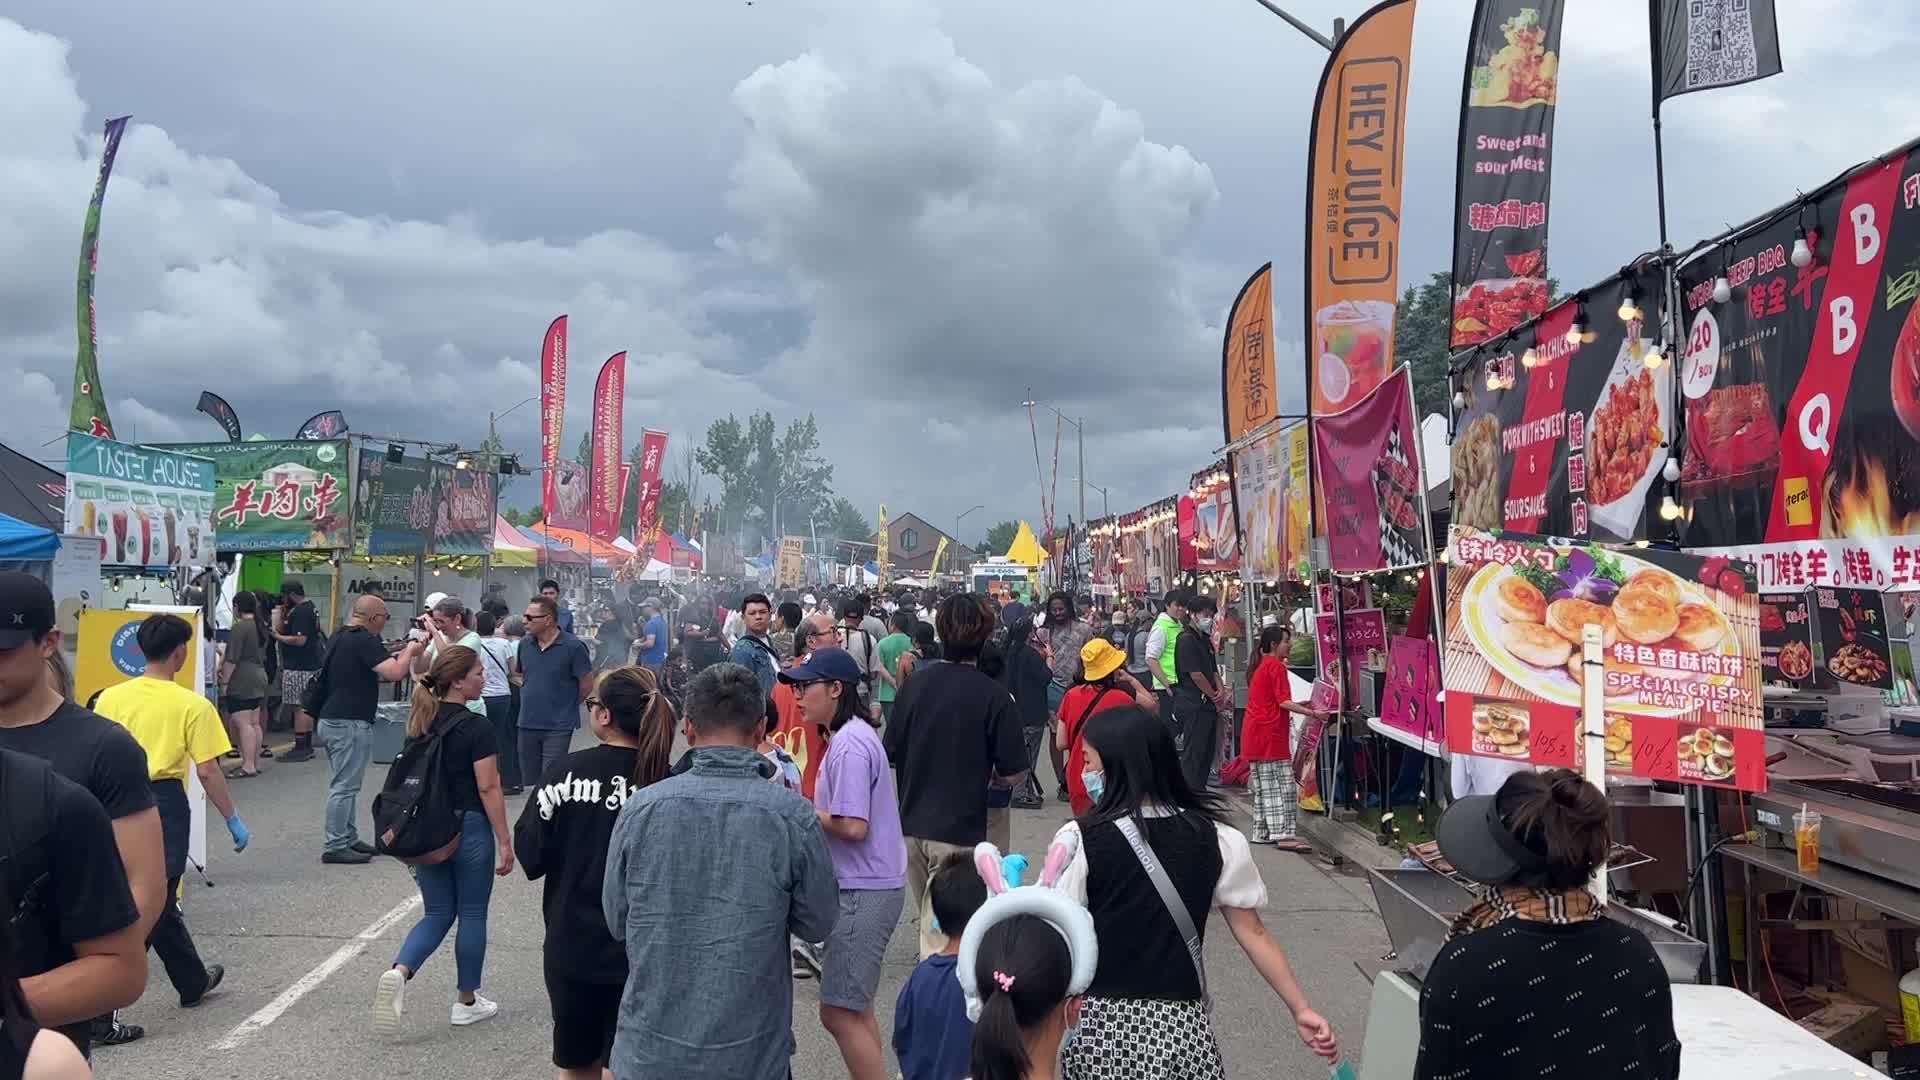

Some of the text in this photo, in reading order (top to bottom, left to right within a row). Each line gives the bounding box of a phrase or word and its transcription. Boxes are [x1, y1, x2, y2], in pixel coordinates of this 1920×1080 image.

[1476, 133, 1546, 151] Sweet and
[1343, 83, 1398, 261] HEY JUICE
[1475, 155, 1544, 175] sour Meat
[1686, 244, 1786, 311] WHOL HEEP BBQ
[152, 456, 202, 489] HOUSE
[218, 472, 342, 525] 羊肉串
[1614, 642, 1744, 676] 特色香酥肉饼
[1607, 672, 1753, 702] SPECIAL CRISPY
[1639, 691, 1722, 713] MEAT PIE
